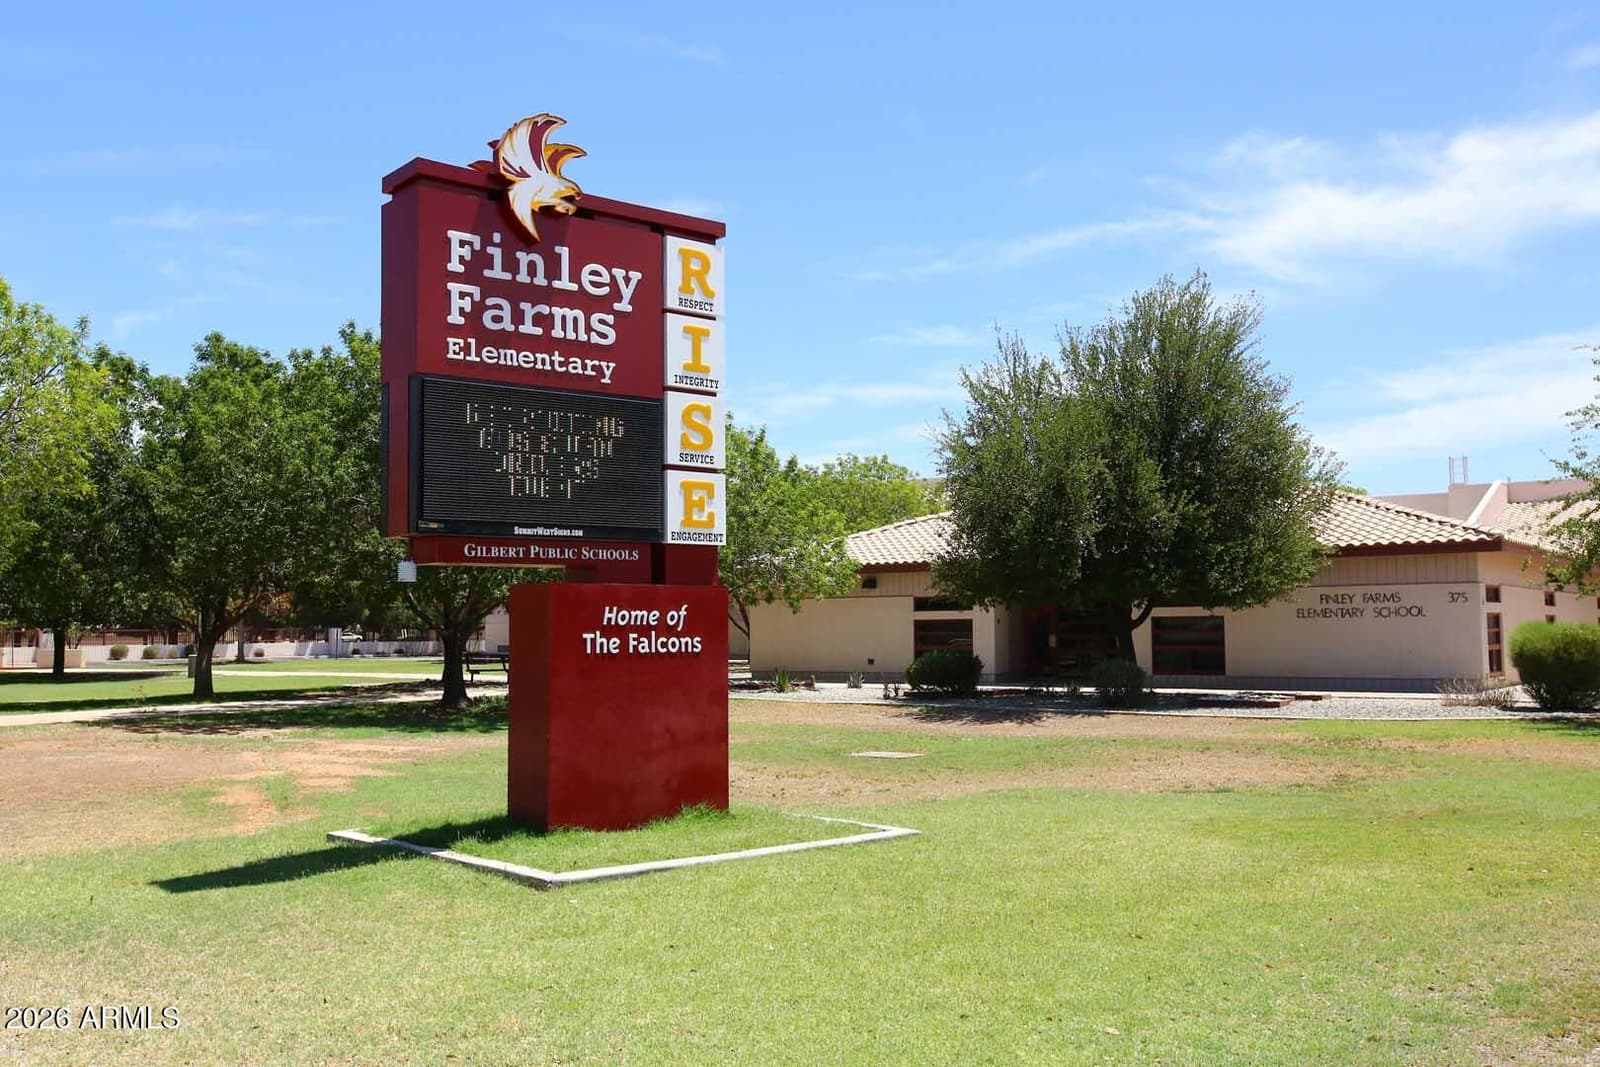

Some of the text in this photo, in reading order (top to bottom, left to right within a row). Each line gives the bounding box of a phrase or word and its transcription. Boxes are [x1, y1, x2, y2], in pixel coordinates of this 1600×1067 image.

[446, 230, 643, 313] Finley
[678, 247, 716, 299] R
[446, 282, 617, 346] Farms
[678, 296, 714, 313] RESPECT
[446, 337, 617, 385] Elementary
[682, 324, 711, 375] I
[673, 374, 720, 390] INTEGRITY
[680, 402, 714, 451] S
[678, 452, 715, 466] SERVICE
[680, 479, 716, 529] E
[670, 531, 724, 544] ENGAGEMENT
[1319, 592, 1402, 606] FINLEY FARMS
[1447, 591, 1469, 604] 375
[602, 604, 689, 631] Home of
[1296, 605, 1427, 620] ELEMENTARY SCHOOL
[582, 631, 703, 655] The Falcons
